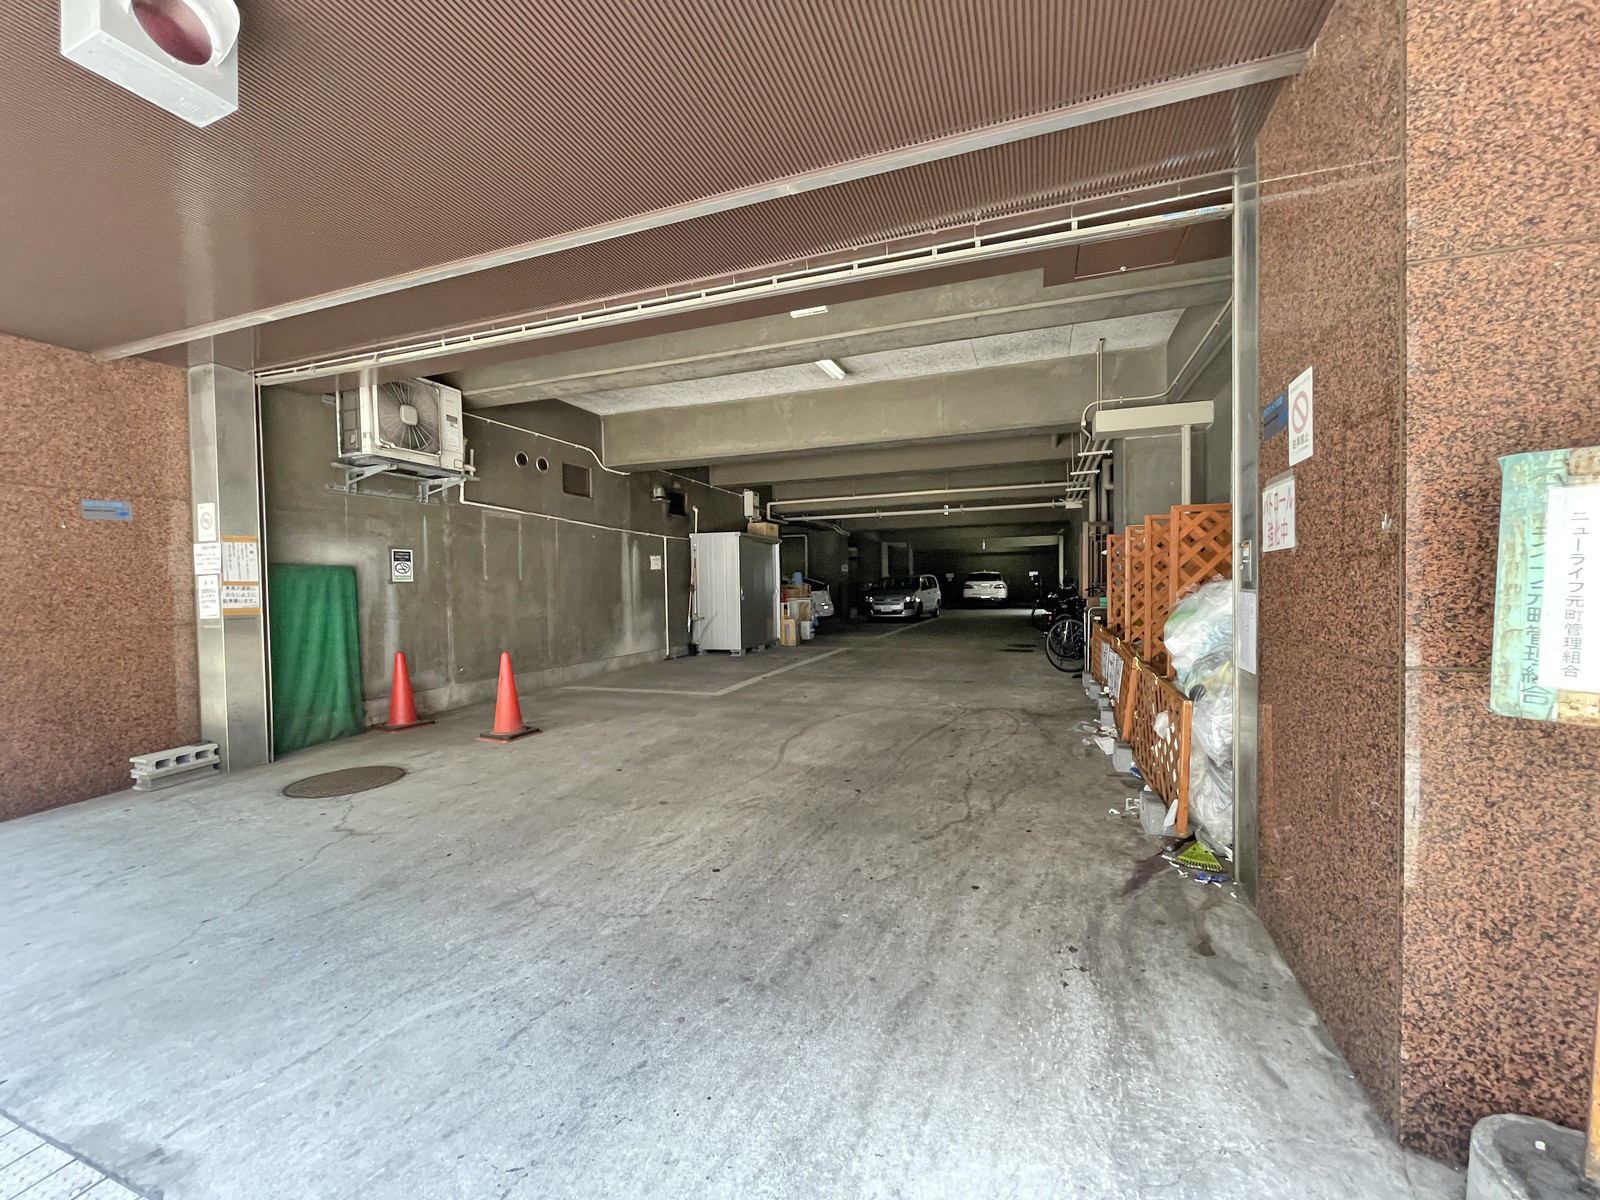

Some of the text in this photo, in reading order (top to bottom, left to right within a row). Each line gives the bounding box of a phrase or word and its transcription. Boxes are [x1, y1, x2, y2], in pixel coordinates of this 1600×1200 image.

[1561, 511, 1590, 679] ニューライフ元町管理組合
